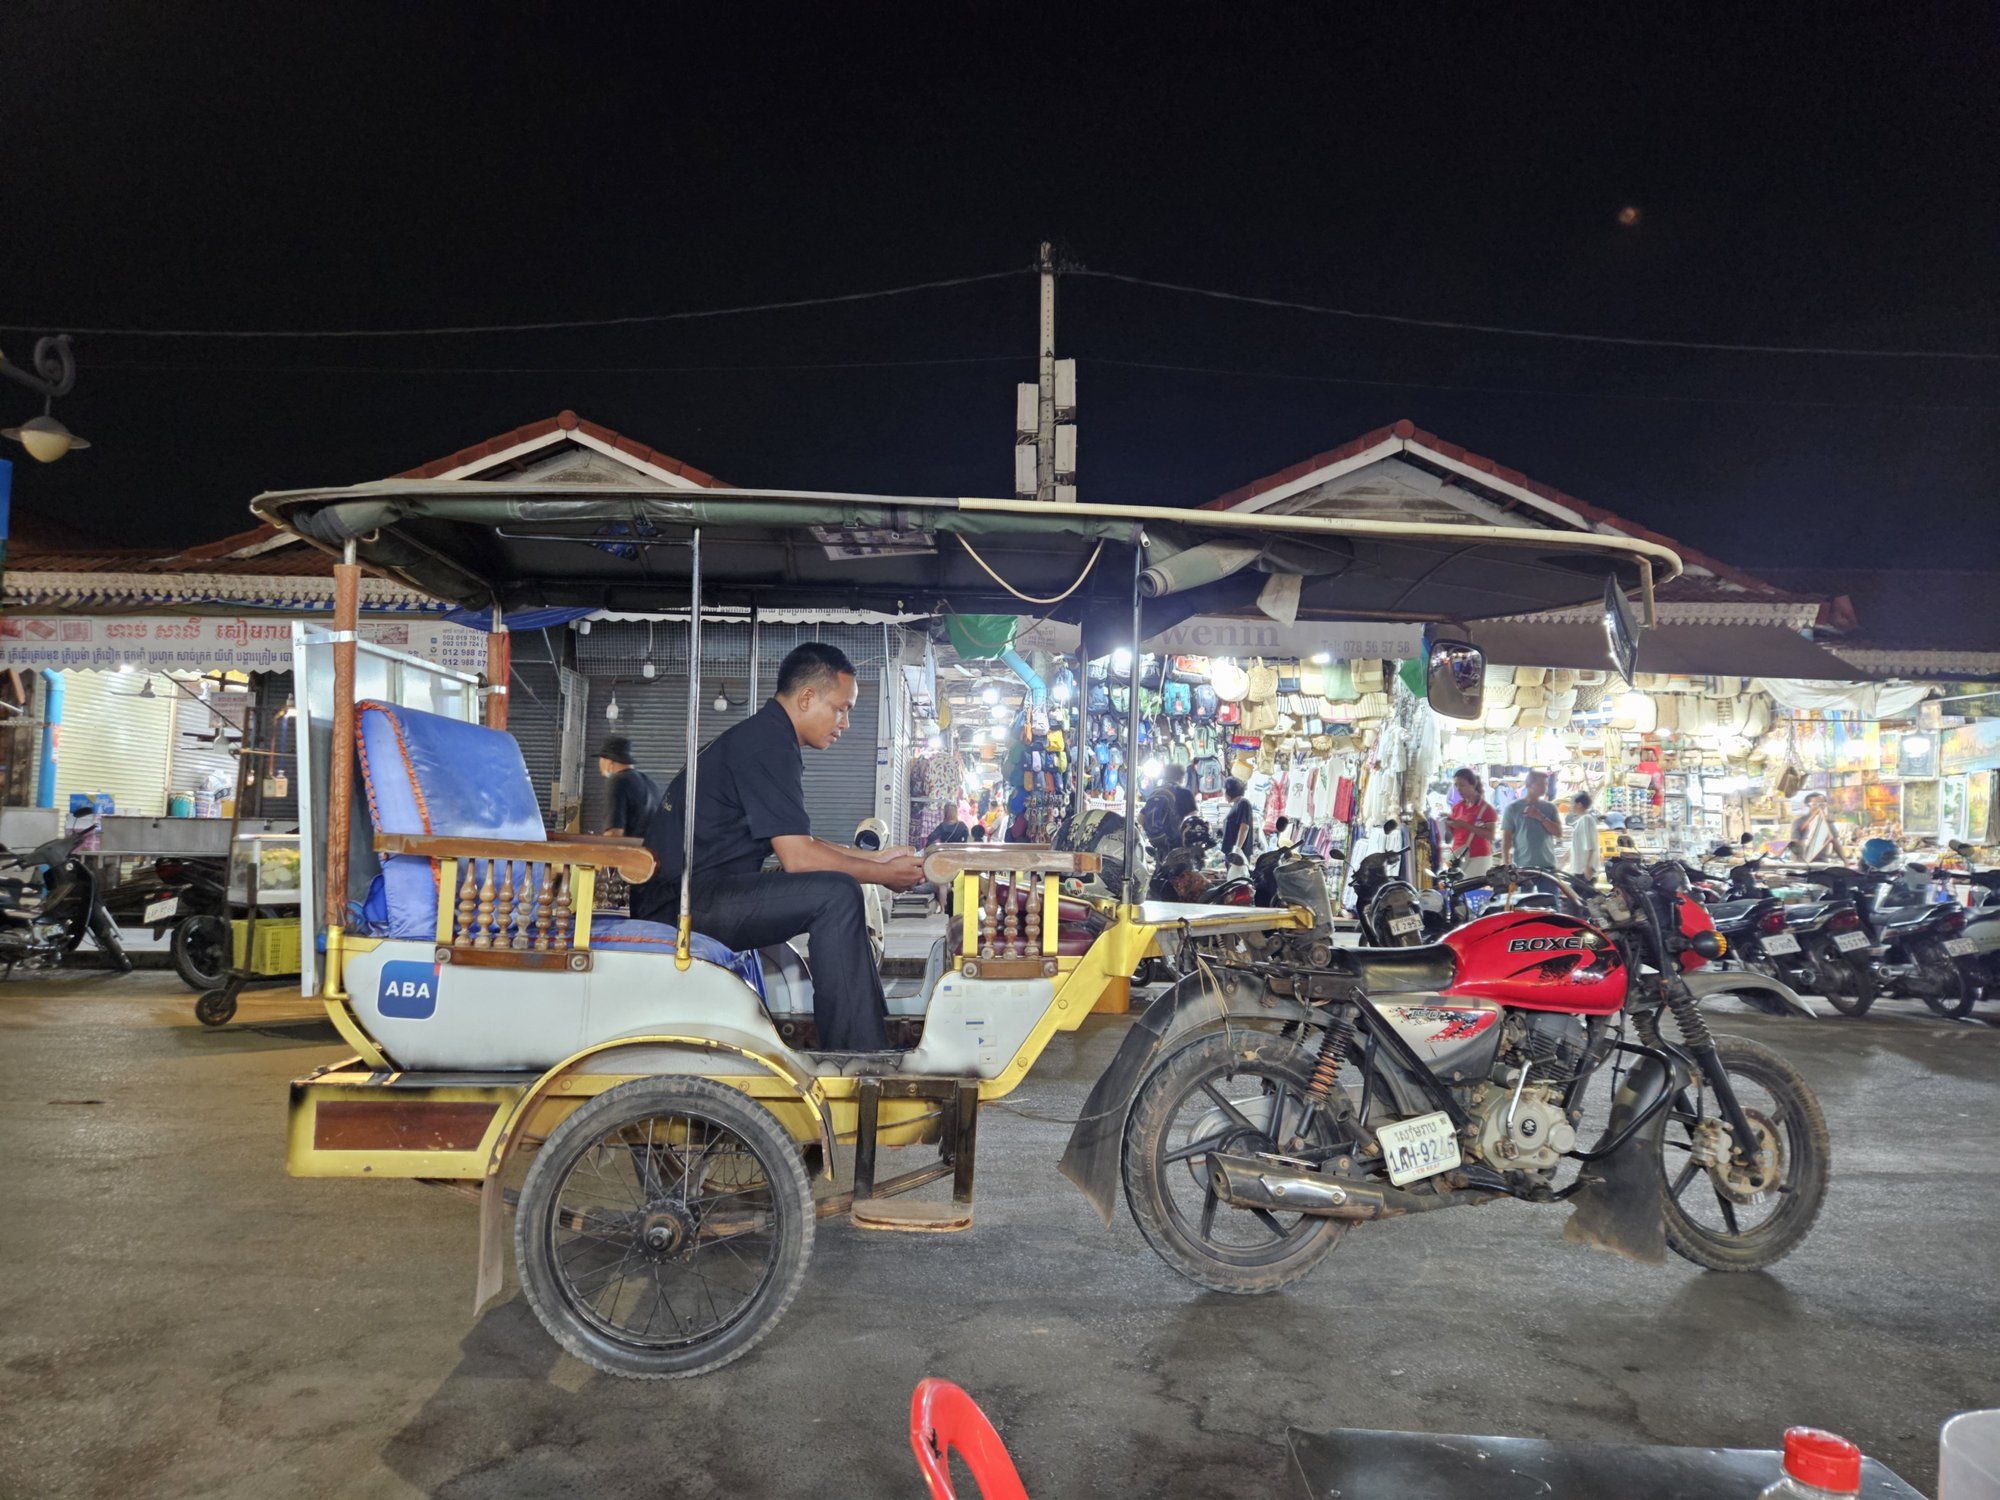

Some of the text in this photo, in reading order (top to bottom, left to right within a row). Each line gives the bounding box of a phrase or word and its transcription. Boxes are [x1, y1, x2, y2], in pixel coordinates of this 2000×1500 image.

[1149, 621, 1280, 648] wenin
[442, 648, 458, 656] 012
[1381, 641, 1394, 653] 57
[442, 658, 458, 666] 012
[1508, 936, 1598, 953] BOXER
[385, 981, 430, 998] ABA
